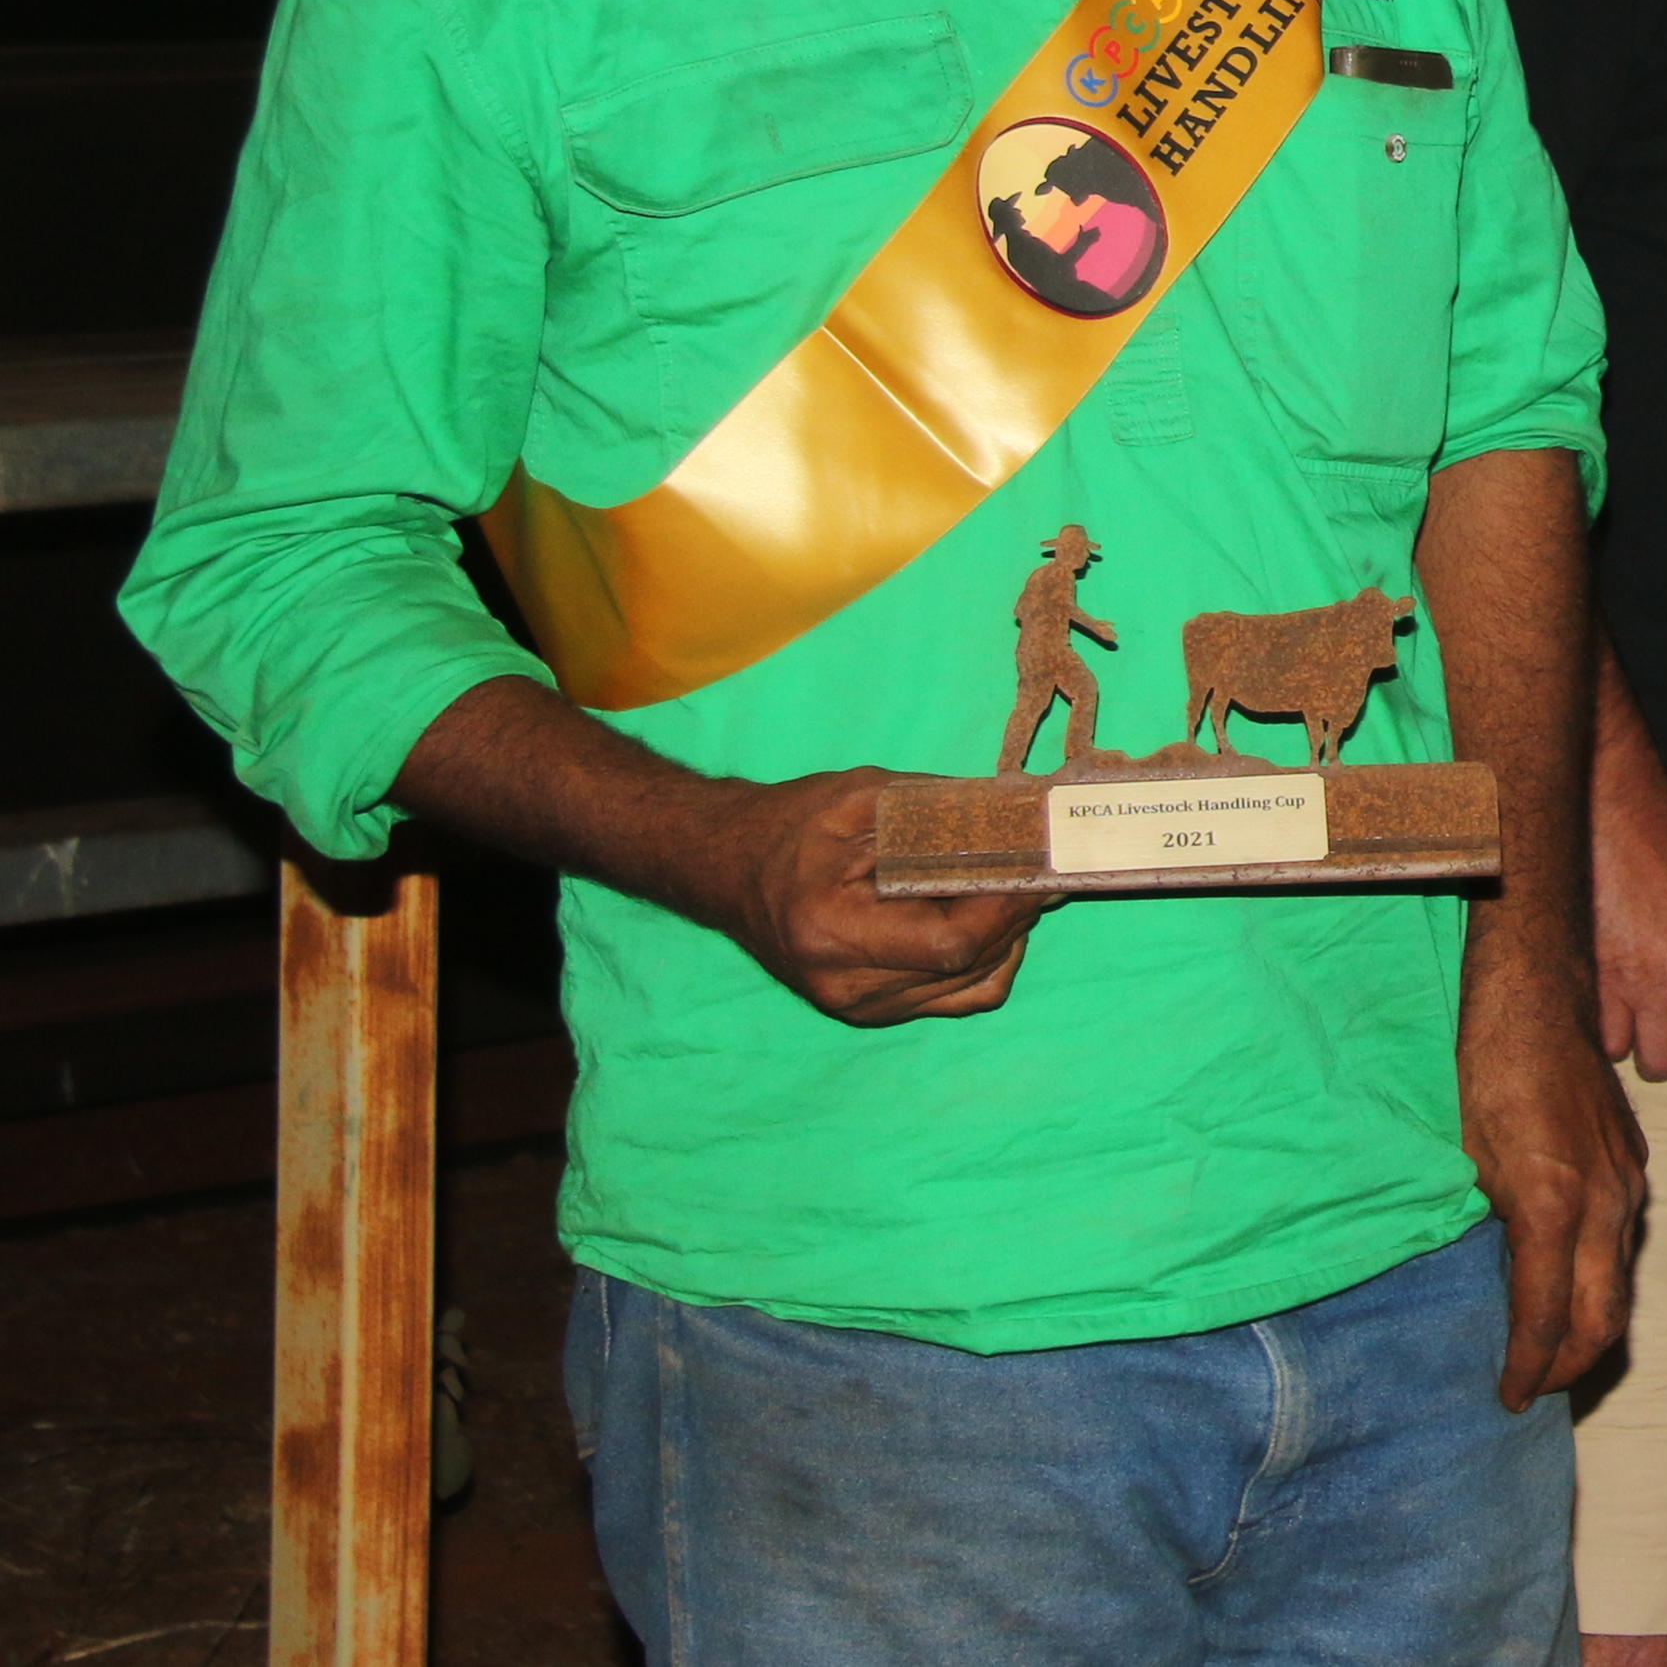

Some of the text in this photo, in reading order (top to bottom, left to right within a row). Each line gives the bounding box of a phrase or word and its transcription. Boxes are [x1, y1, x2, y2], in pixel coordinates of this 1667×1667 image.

[1069, 795, 1306, 818] KPCA Livestock Handling Cup
[1163, 830, 1217, 848] 2021
